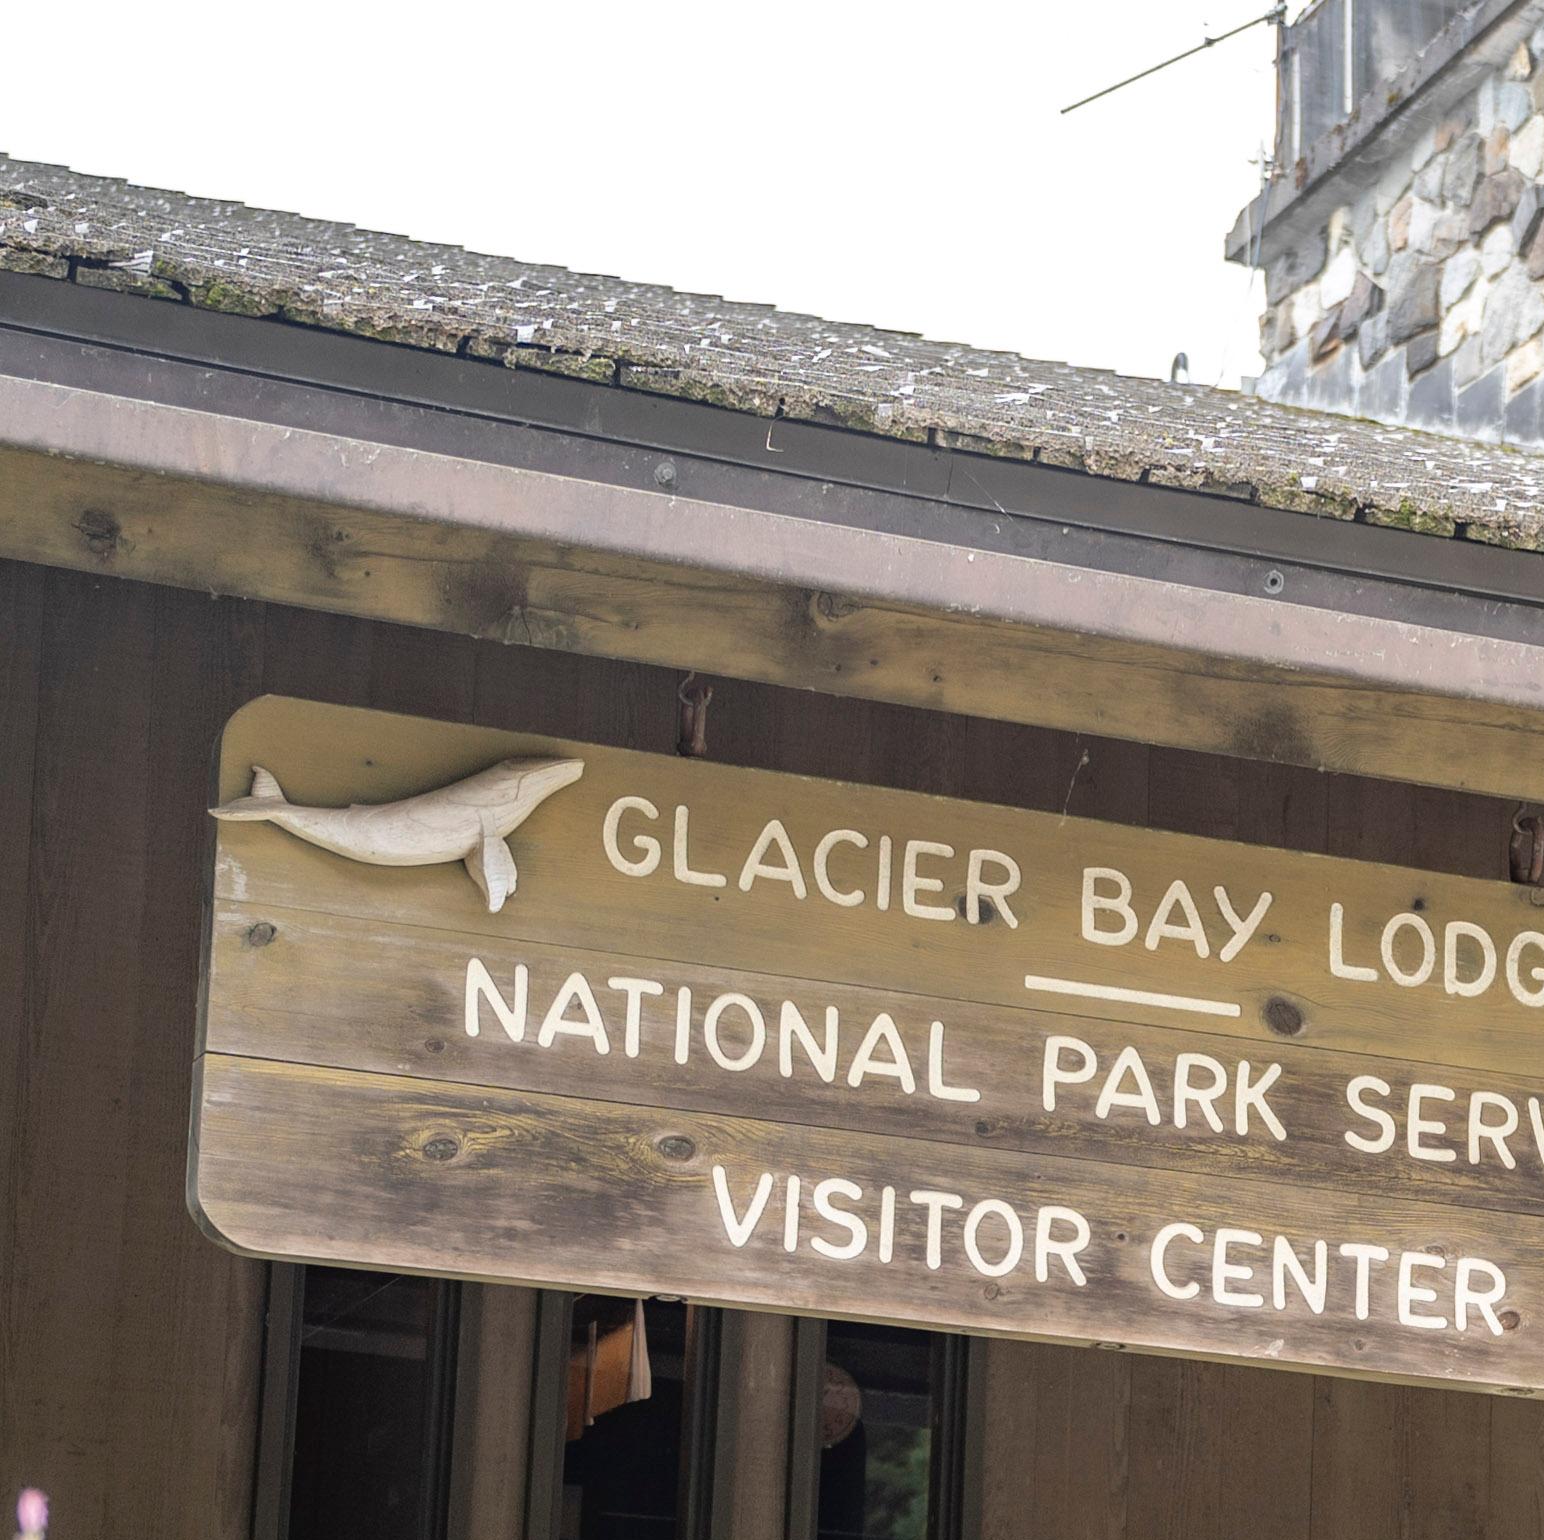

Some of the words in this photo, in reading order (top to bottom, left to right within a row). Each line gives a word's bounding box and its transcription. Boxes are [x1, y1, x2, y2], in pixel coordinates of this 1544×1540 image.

[604, 797, 1021, 929] GLACIER
[1082, 868, 1272, 962] BAY
[464, 958, 981, 1103] NATIONAL
[1043, 1036, 1287, 1141] PARK
[712, 1165, 1091, 1287] VISITOR
[1151, 1223, 1507, 1337] CENTER
